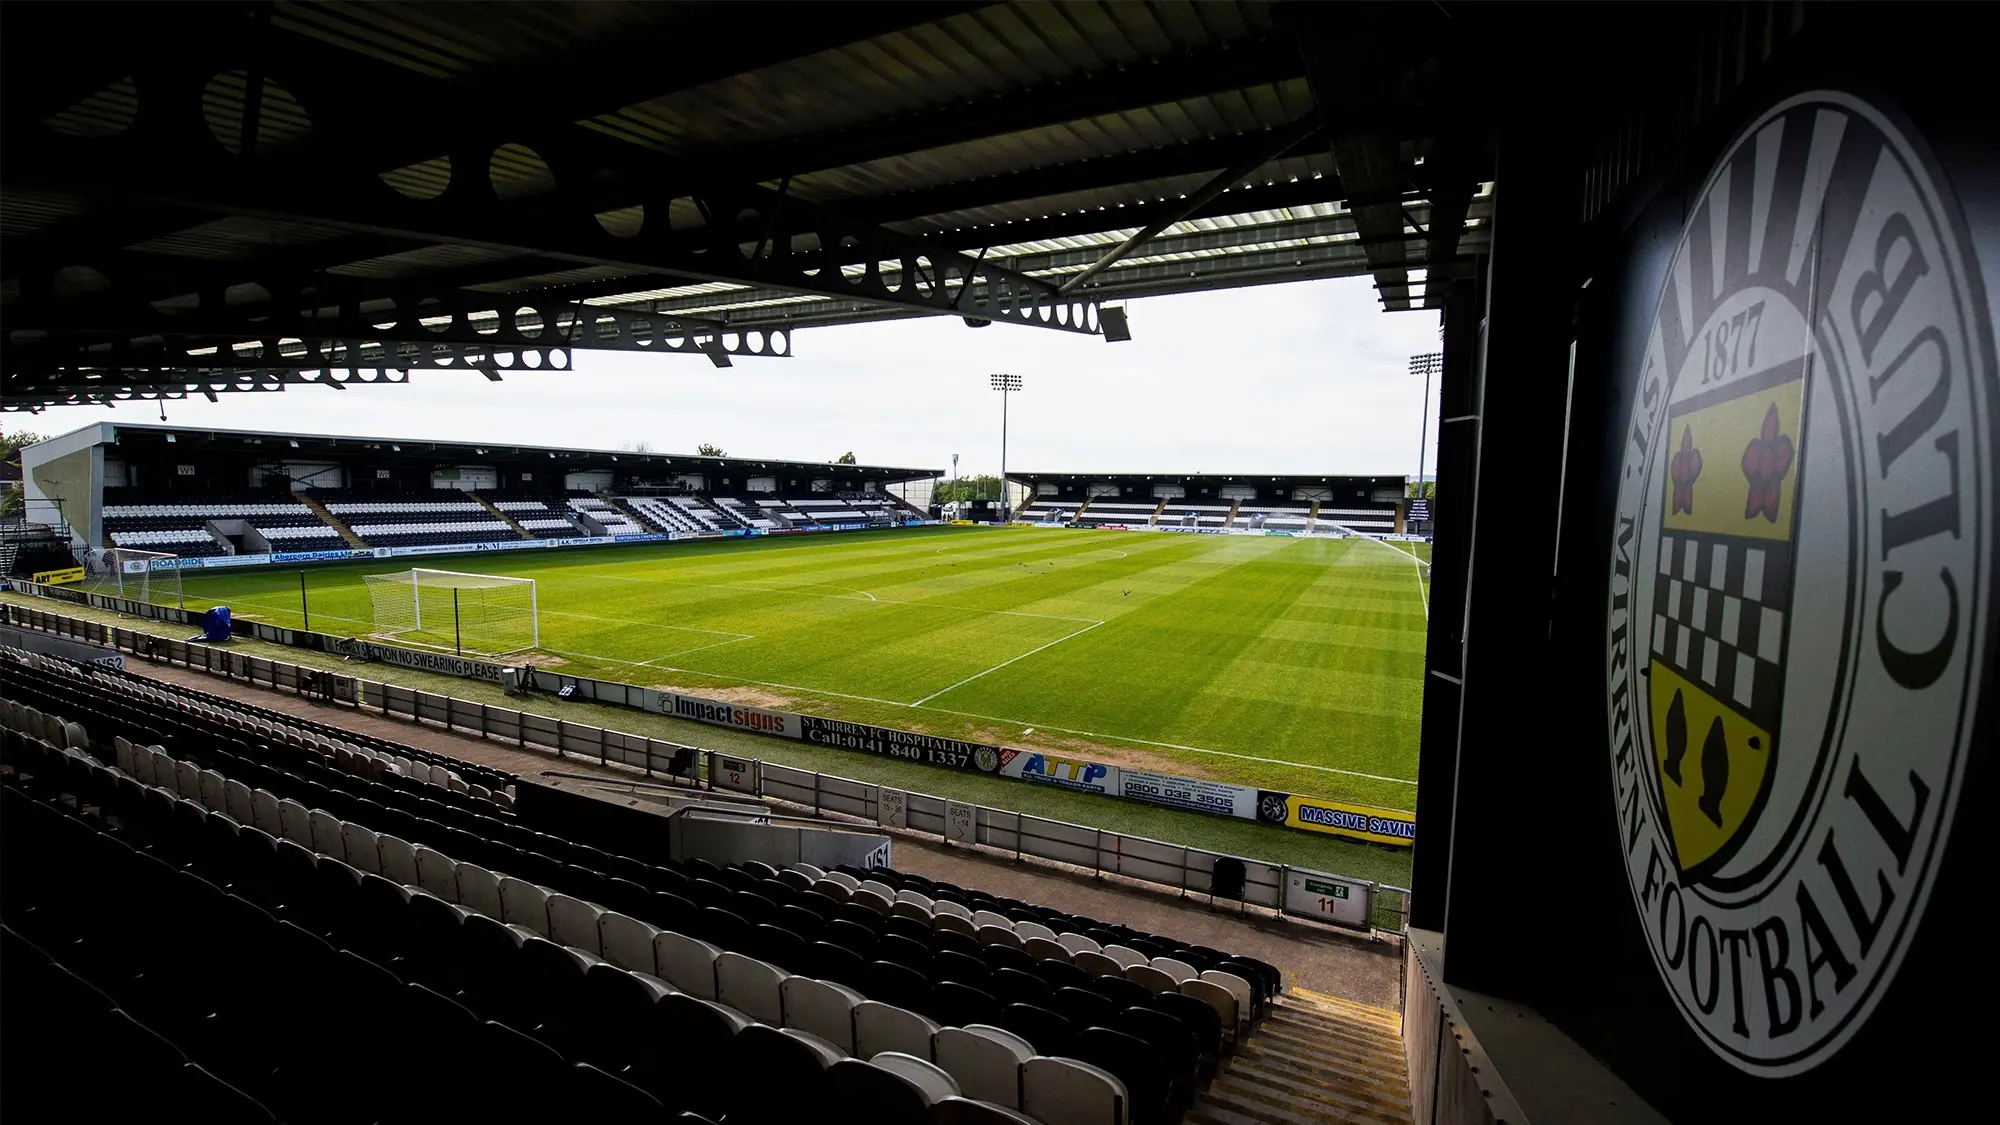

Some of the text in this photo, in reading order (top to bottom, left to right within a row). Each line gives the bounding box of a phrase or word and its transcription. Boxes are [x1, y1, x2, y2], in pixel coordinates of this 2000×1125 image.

[1701, 299, 1765, 386] 1877
[274, 553, 309, 561] Abercorn
[312, 551, 338, 559] Dairies
[35, 575, 50, 584] ART
[1611, 211, 1961, 1039] ST. MIRREN FOOTBALL CLUB
[400, 651, 413, 665] NO
[413, 653, 462, 675] SWEARING
[463, 661, 500, 681] PLEASE
[675, 695, 785, 733] Impactsigns
[803, 717, 973, 755] ST. MIRREN FC HOSPITALITY
[890, 743, 920, 760] 840
[928, 750, 968, 768] 1337
[1023, 753, 1107, 783] ATTP
[729, 772, 740, 785] 12
[882, 793, 902, 804] SEATS
[1125, 782, 1233, 807] 0800 032 3505
[950, 808, 971, 819] SEATS
[962, 819, 969, 827] 14
[1301, 806, 1367, 831] MASSIVE
[868, 844, 888, 870] VS1
[1318, 897, 1335, 913] 11
